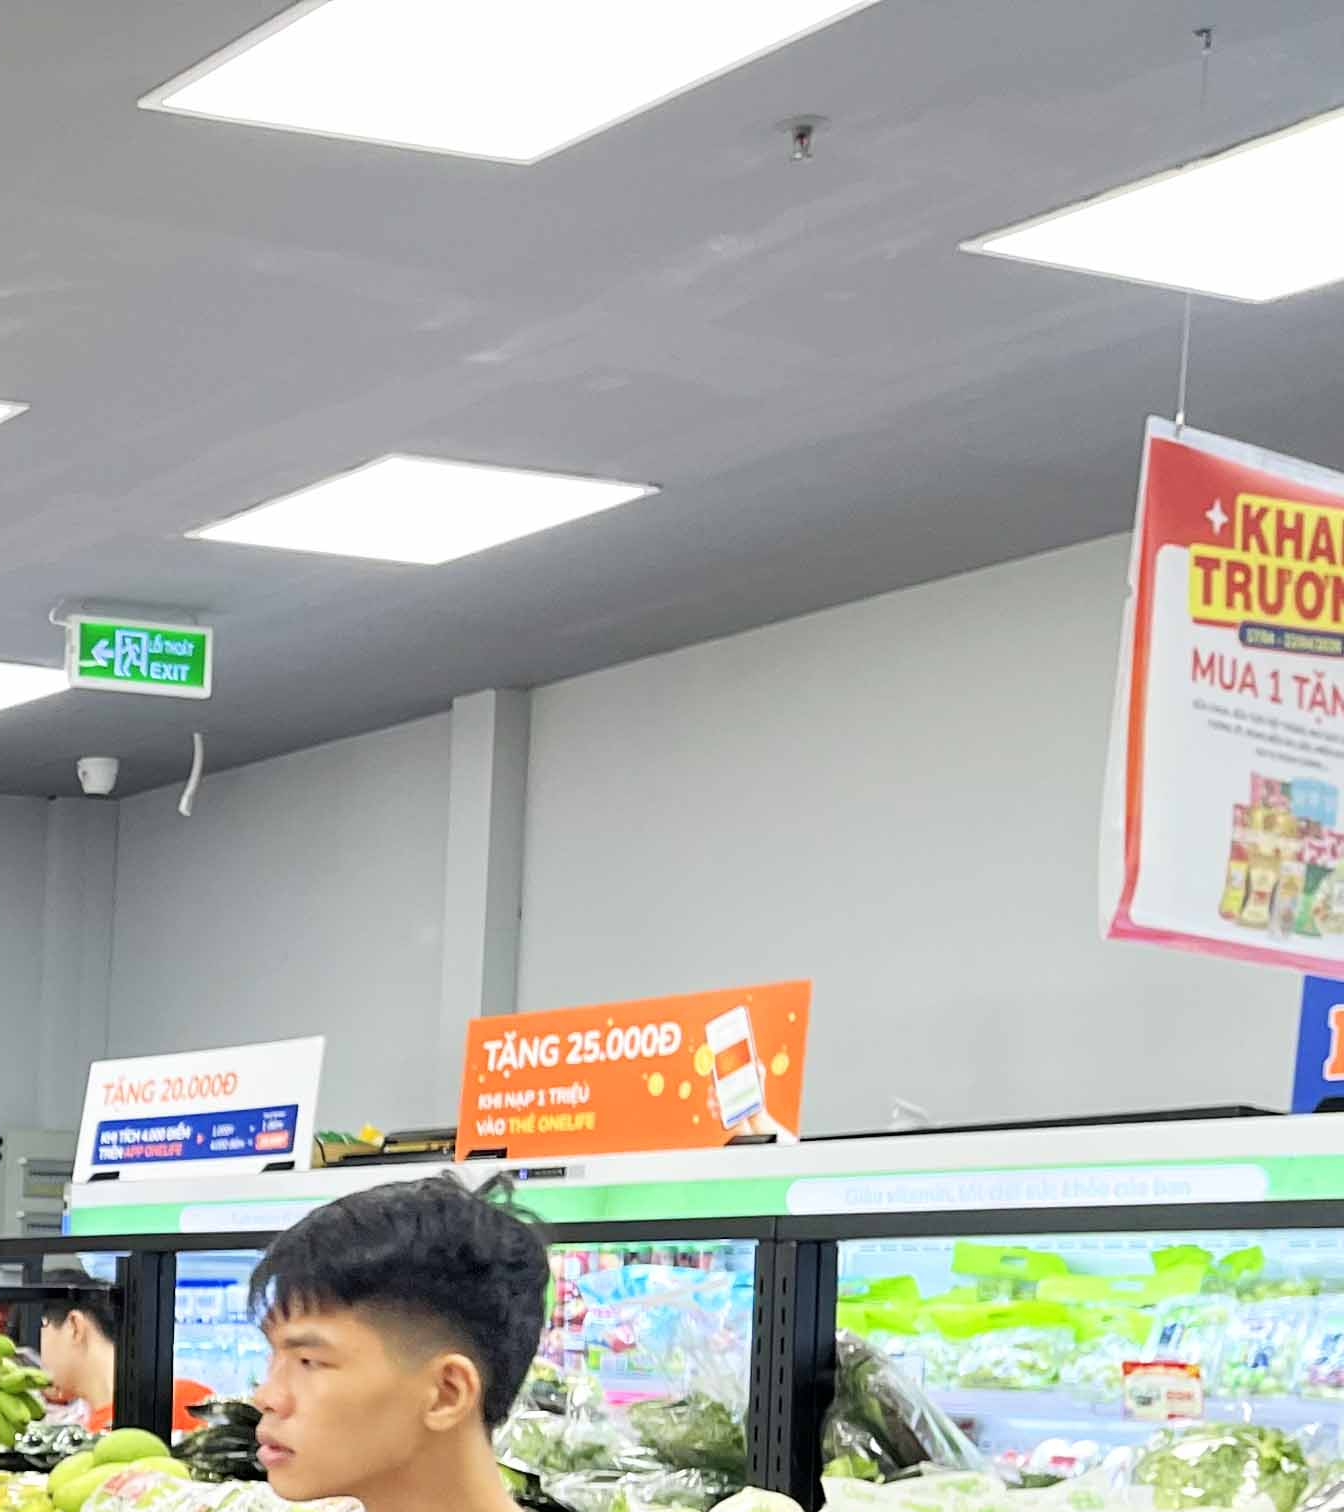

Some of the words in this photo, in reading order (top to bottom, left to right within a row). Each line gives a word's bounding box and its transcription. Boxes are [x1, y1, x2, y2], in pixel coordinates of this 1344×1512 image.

[149, 662, 191, 682] EXIT
[1191, 646, 1259, 699] MUA
[1268, 669, 1283, 704] 1
[483, 1032, 560, 1079] TẶNG
[566, 1021, 682, 1066] 25.000Đ
[101, 1076, 156, 1111] TẶNG
[159, 1071, 239, 1102] 20.000Đ
[478, 1092, 504, 1110] KHI
[505, 1090, 536, 1112] NẠP
[476, 1114, 506, 1137] VÀO
[509, 1112, 537, 1134] THẺ
[538, 1111, 596, 1132] ONELIFE
